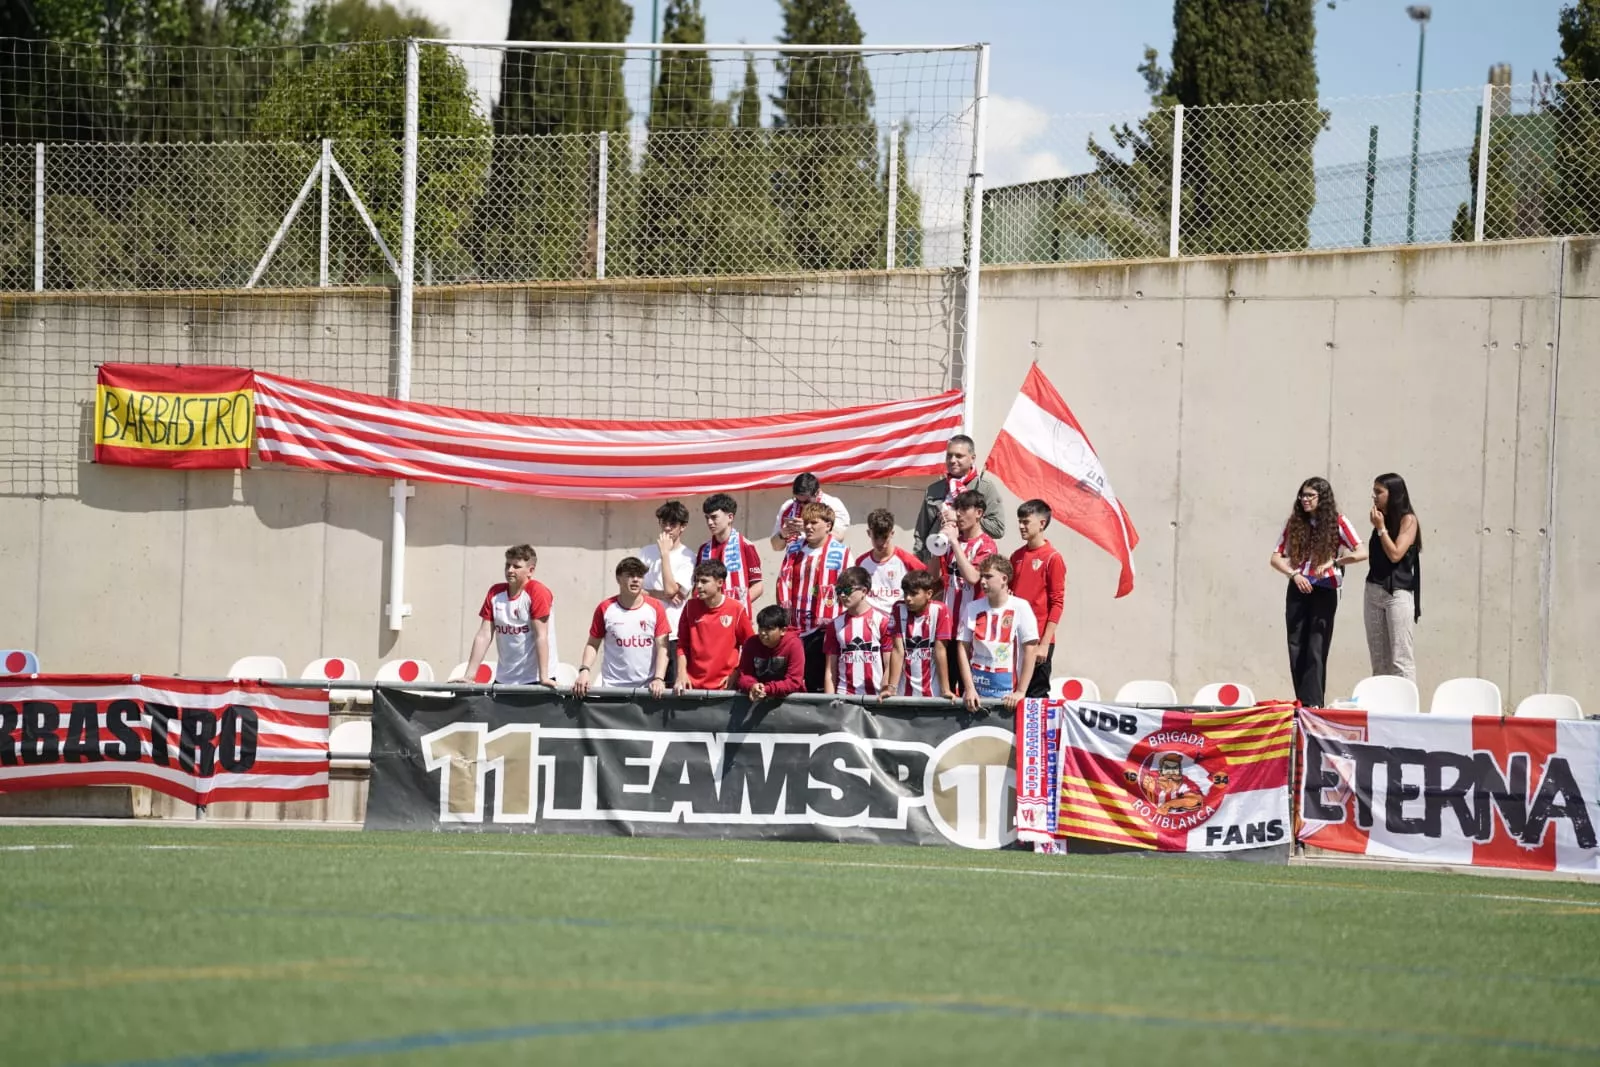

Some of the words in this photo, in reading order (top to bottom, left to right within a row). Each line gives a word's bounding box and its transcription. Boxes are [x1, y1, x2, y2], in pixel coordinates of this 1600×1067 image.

[102, 391, 250, 446] BARBASTRO
[1079, 707, 1138, 735] UDB
[1148, 731, 1205, 748] BRIGADA
[1214, 775, 1229, 785] 34
[1302, 731, 1598, 849] ETERNA
[1132, 799, 1216, 830] ROJIBLANCA
[1206, 819, 1284, 846] FANS
